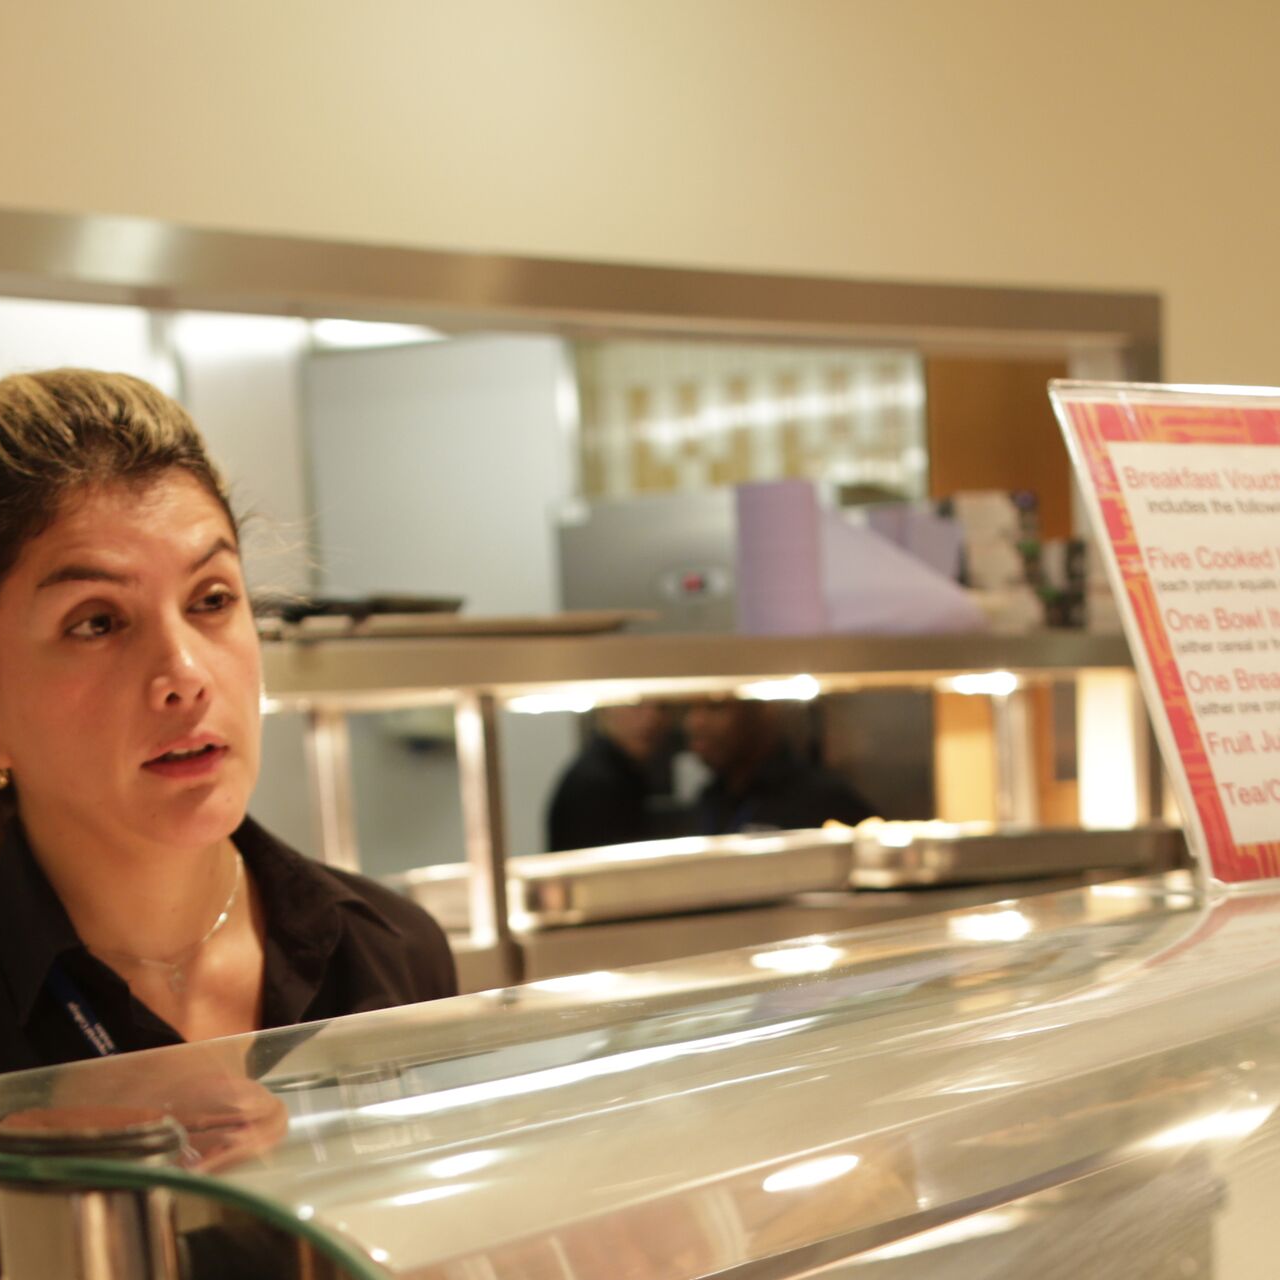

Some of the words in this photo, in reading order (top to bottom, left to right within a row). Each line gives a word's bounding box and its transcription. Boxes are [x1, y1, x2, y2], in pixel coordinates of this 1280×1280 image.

[1123, 466, 1218, 490] Breakfast
[1147, 500, 1208, 514] includes
[1210, 500, 1233, 514] the
[1146, 547, 1192, 569] Five
[1195, 546, 1274, 569] Cooked
[1166, 608, 1211, 631] One
[1214, 607, 1265, 630] Bowl
[1186, 670, 1232, 694] One
[1205, 731, 1257, 755] Fruit
